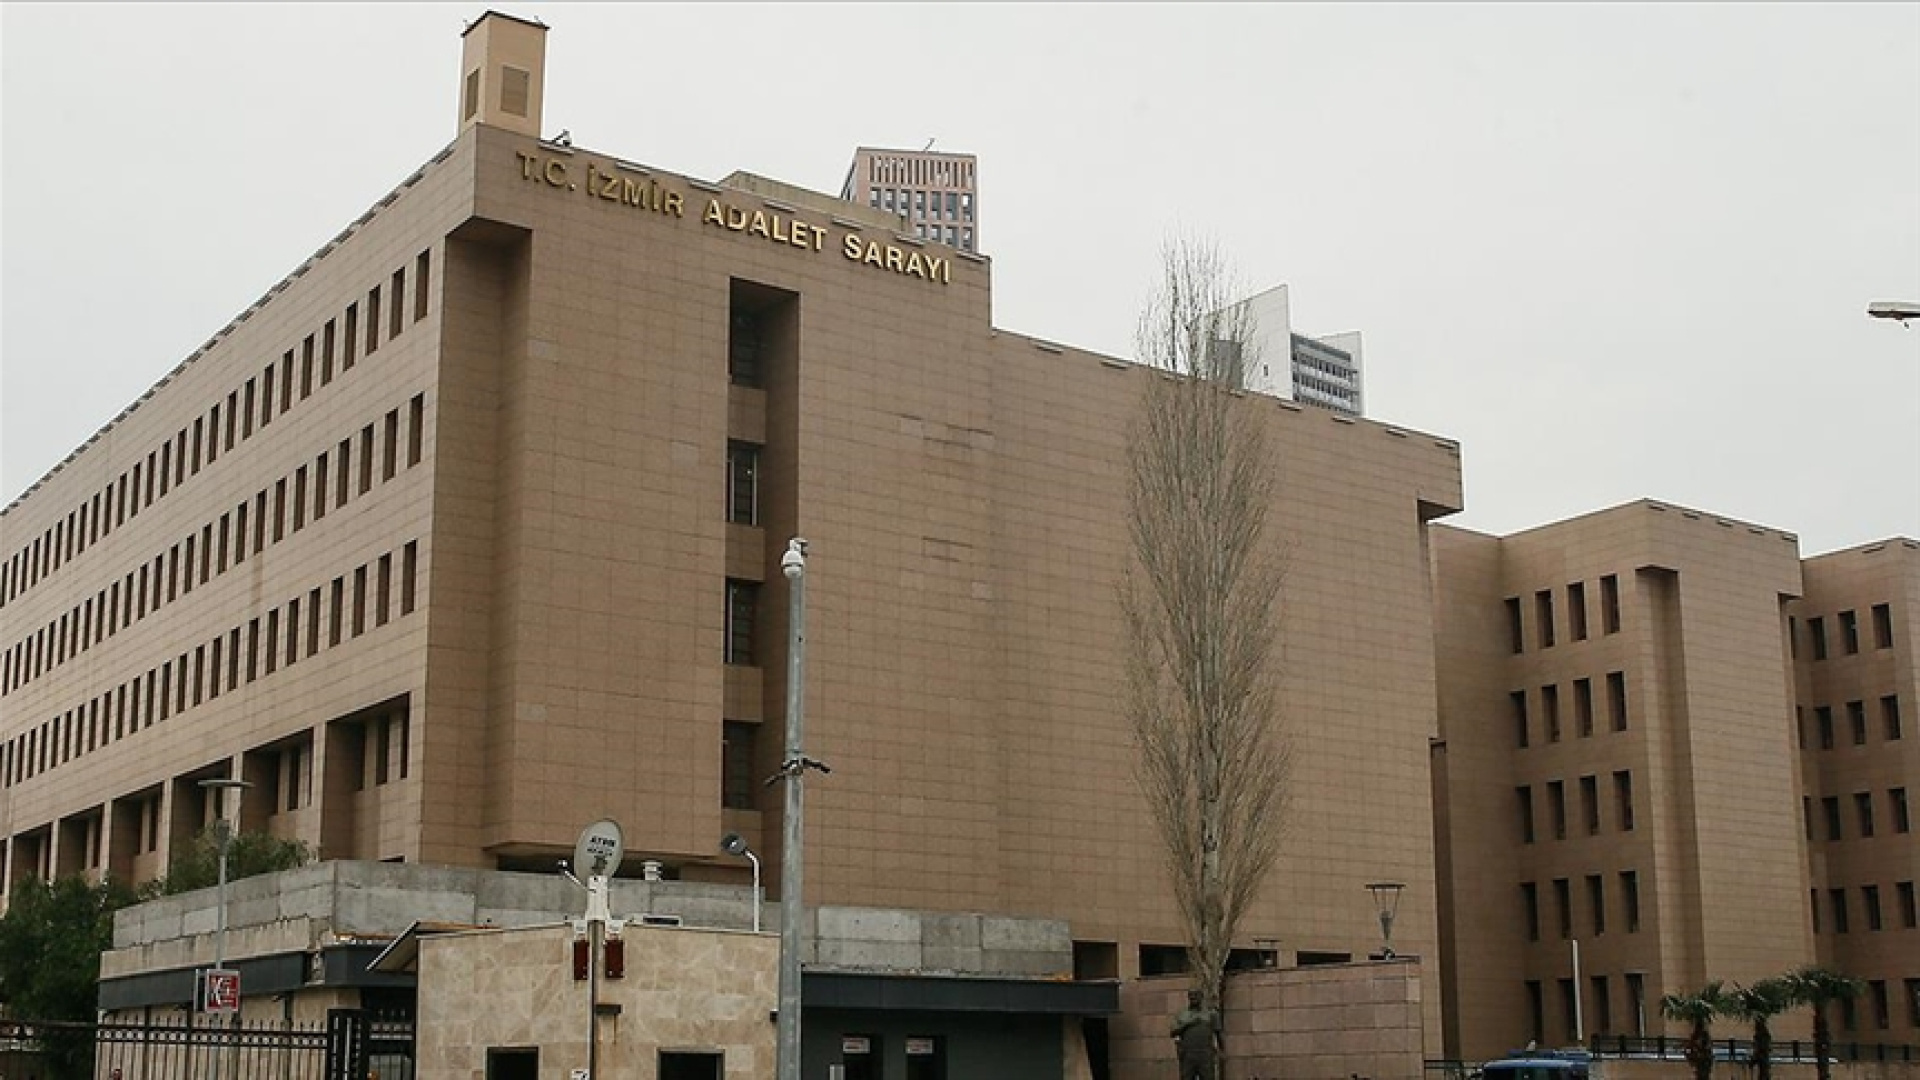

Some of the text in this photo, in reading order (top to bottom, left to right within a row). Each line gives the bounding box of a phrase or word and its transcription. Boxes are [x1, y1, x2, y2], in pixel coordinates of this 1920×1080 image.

[516, 150, 952, 285] T.C. İZMİR ADALET SARAYI
